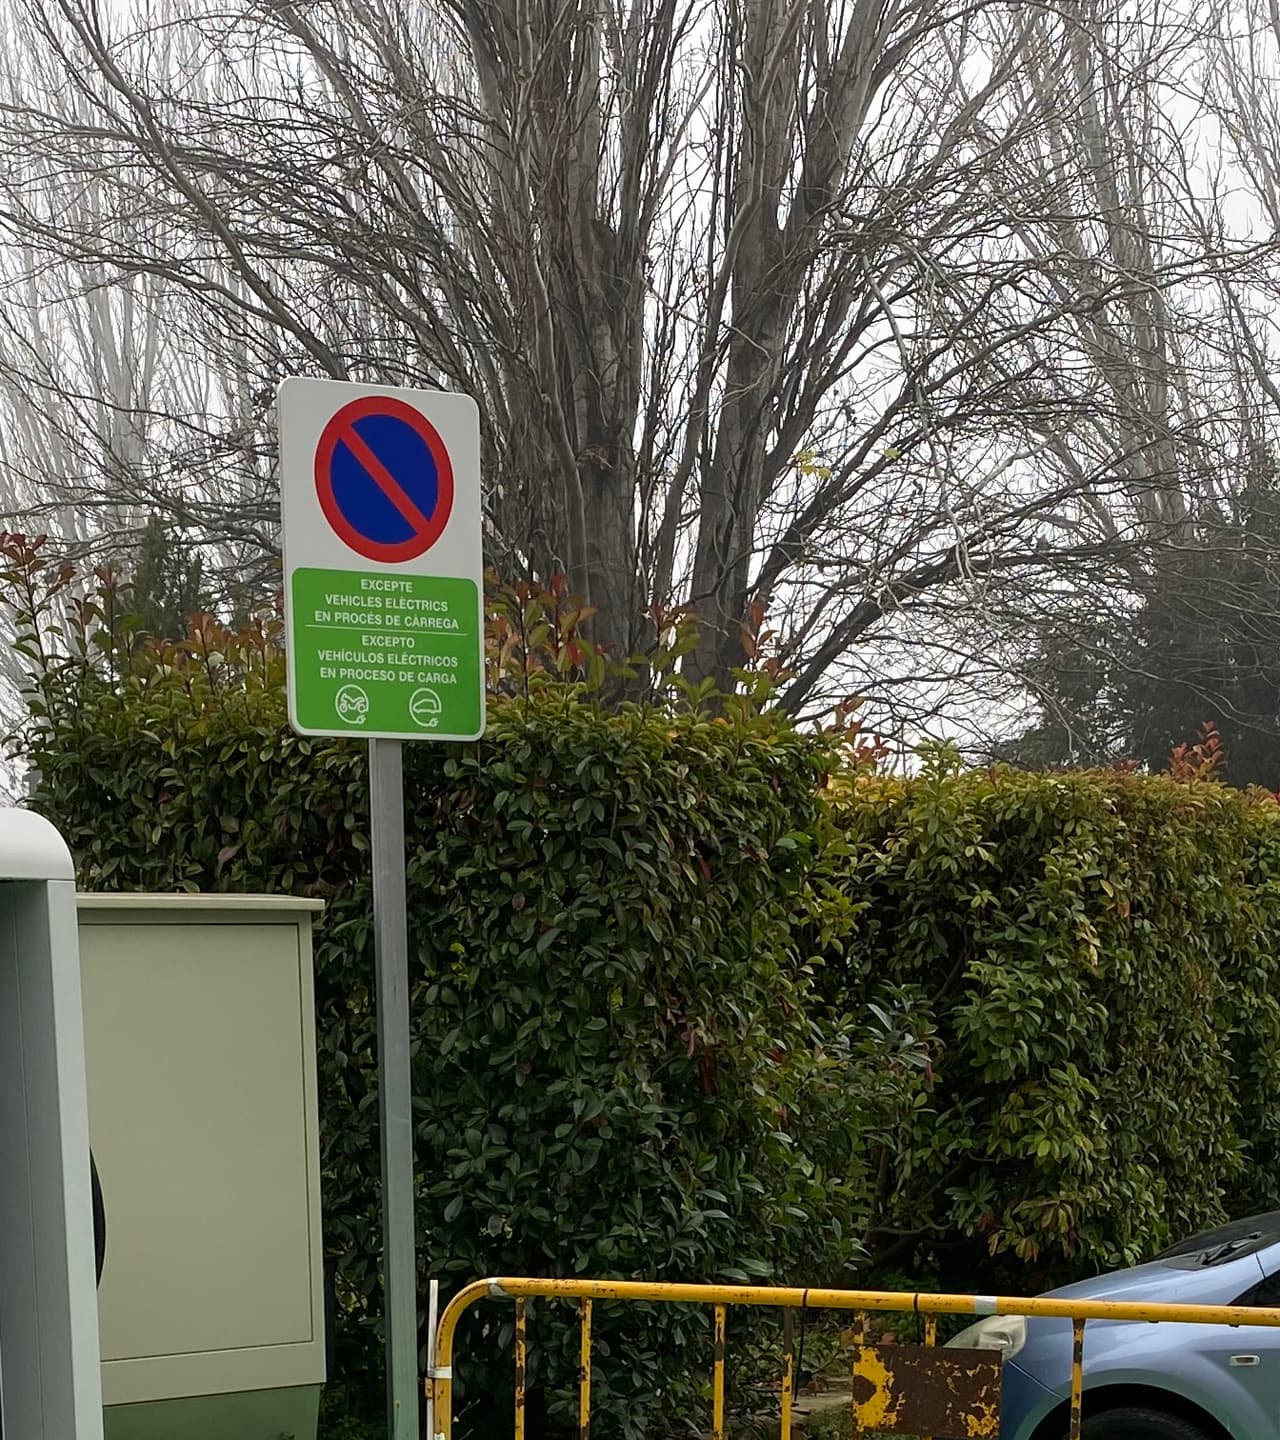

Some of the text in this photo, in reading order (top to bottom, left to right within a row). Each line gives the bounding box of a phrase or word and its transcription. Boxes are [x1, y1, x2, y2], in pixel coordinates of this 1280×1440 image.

[360, 578, 413, 593] EXCEPTE
[325, 594, 448, 612] VEHICLES ELÈCTRICS
[314, 610, 460, 629] EN PROCÉS DE CÀRREGA
[361, 635, 415, 648] EXCEPTO
[318, 648, 458, 667] VEHÍCULOS ELÉCTRICOS
[320, 667, 457, 684] EN PROCESO DE CARGA
